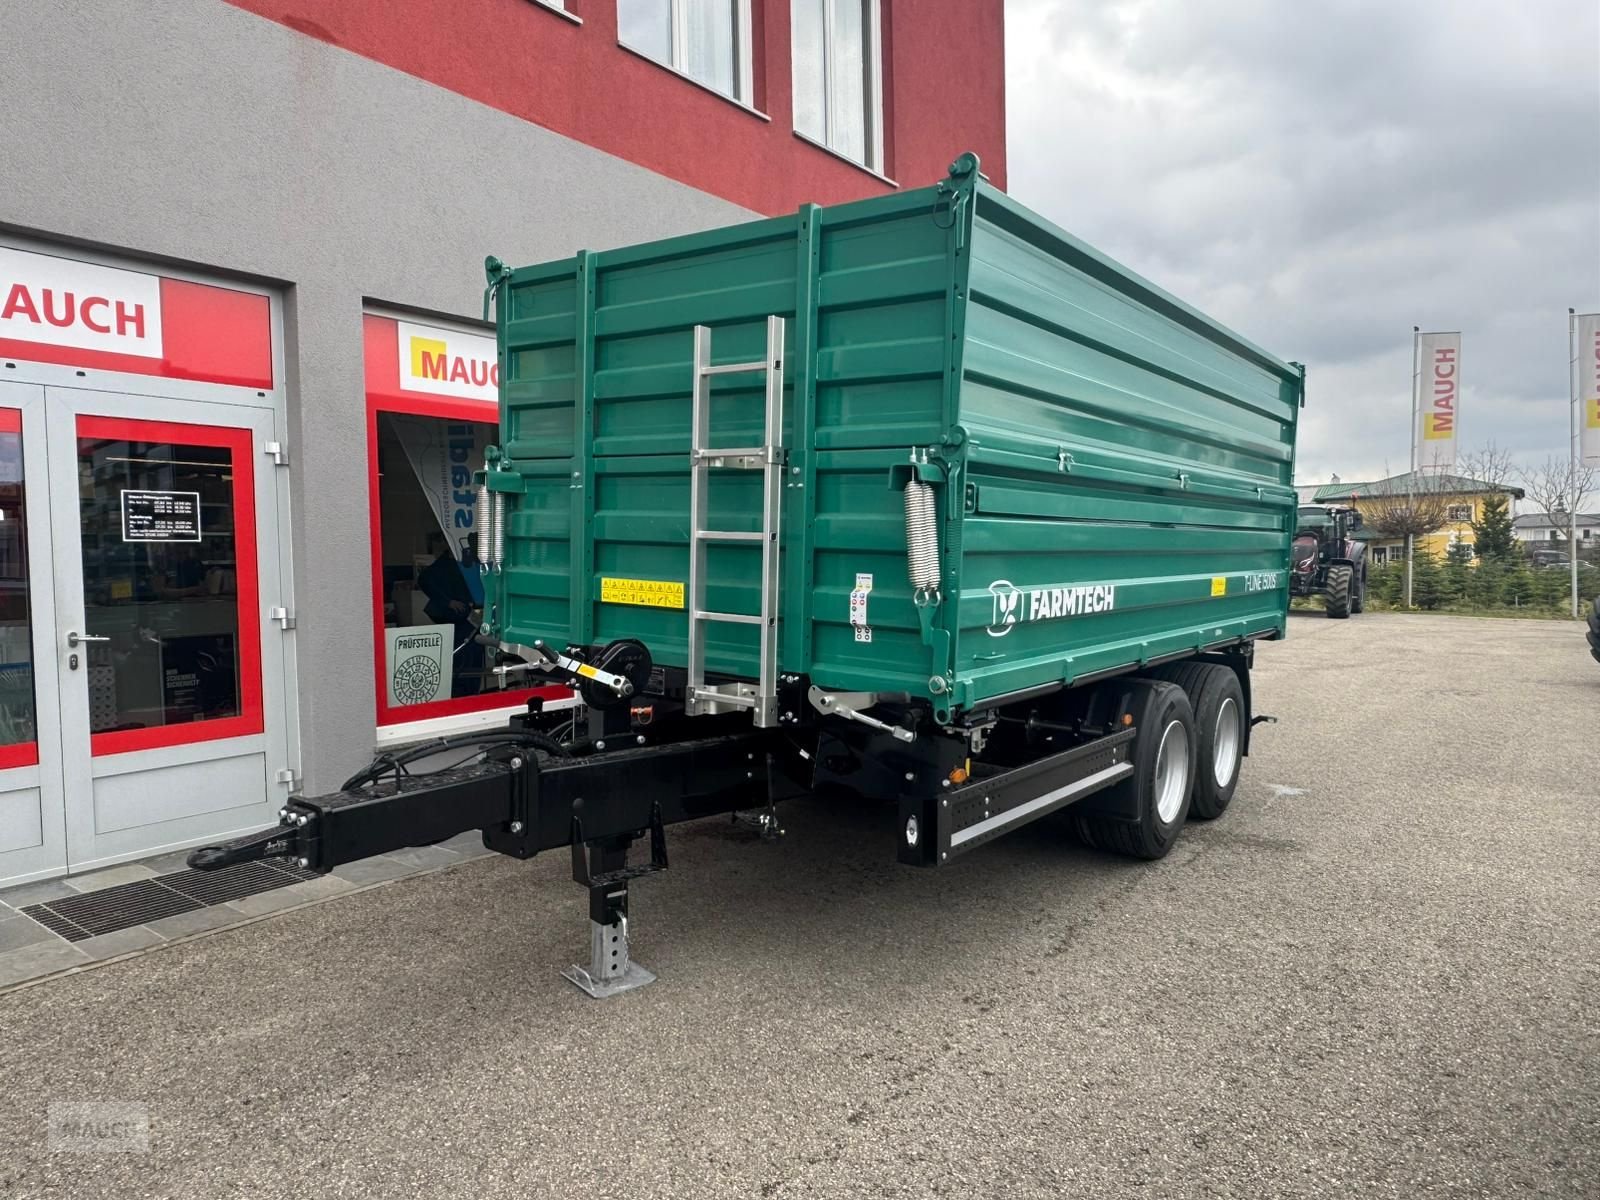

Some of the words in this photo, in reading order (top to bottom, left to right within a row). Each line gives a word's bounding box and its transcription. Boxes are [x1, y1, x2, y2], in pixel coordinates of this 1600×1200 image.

[1432, 348, 1456, 432] MAUCH
[1029, 584, 1115, 620] FARMTECH
[398, 637, 440, 650] PRÜFSTELLE
